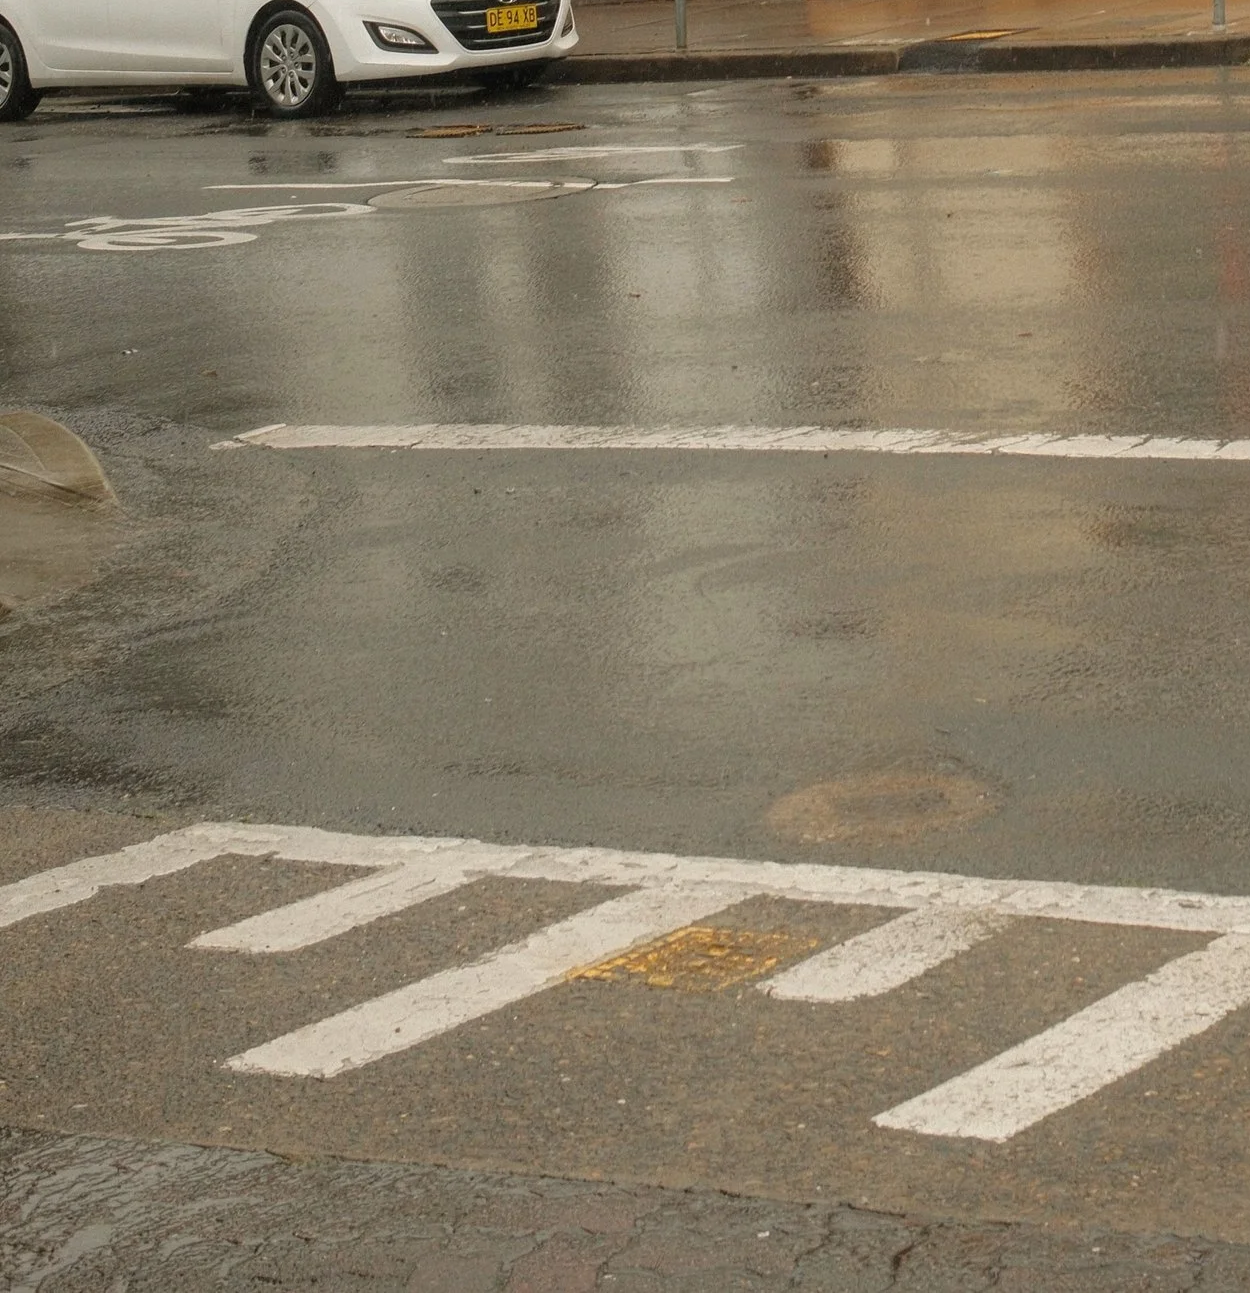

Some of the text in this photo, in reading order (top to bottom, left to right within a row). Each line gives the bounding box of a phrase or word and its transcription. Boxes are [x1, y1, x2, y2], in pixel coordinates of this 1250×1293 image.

[489, 7, 536, 27] DE 94 XB
